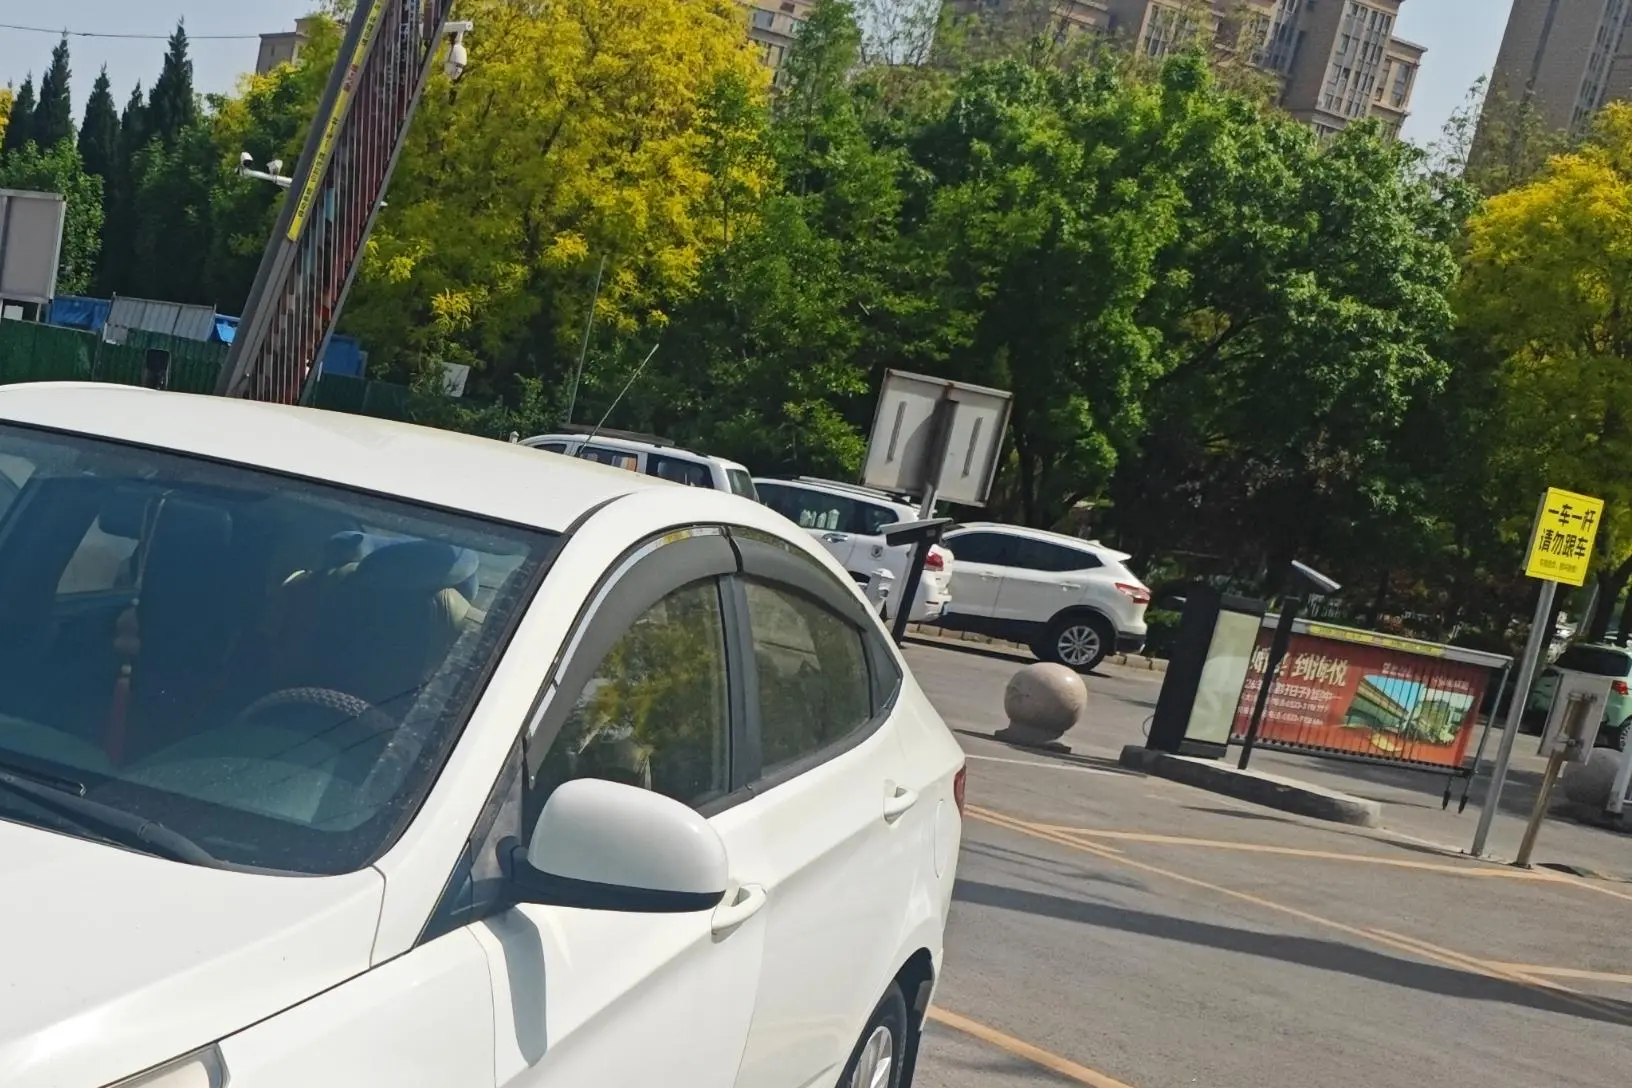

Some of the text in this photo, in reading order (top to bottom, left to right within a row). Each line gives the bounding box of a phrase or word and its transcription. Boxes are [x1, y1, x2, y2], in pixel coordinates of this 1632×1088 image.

[1548, 503, 1596, 532] 一车一杆
[1538, 528, 1588, 560] 请勿跟车
